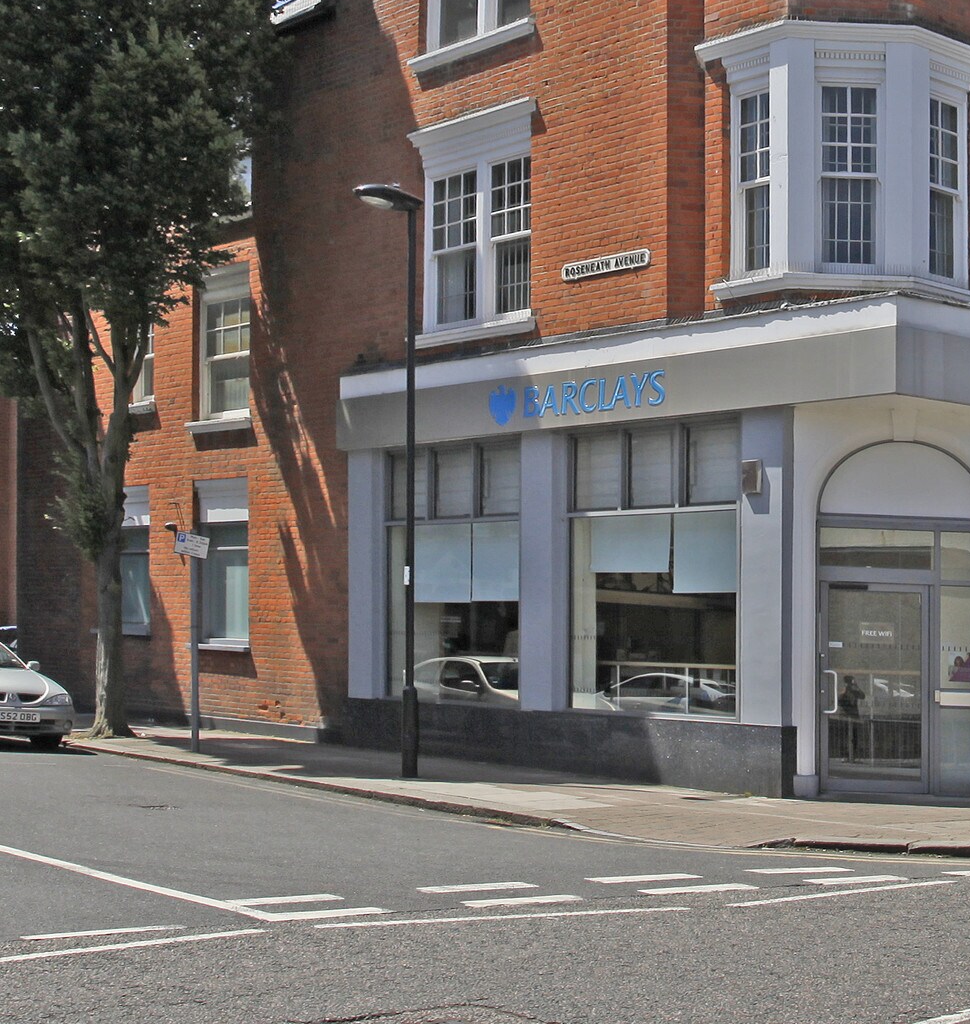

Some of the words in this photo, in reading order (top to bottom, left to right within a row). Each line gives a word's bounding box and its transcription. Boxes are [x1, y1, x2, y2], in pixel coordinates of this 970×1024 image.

[565, 260, 612, 278] ROSENEATH
[615, 253, 647, 269] AVENUE
[523, 369, 666, 419] BARCLAYS
[0, 712, 18, 720] S52
